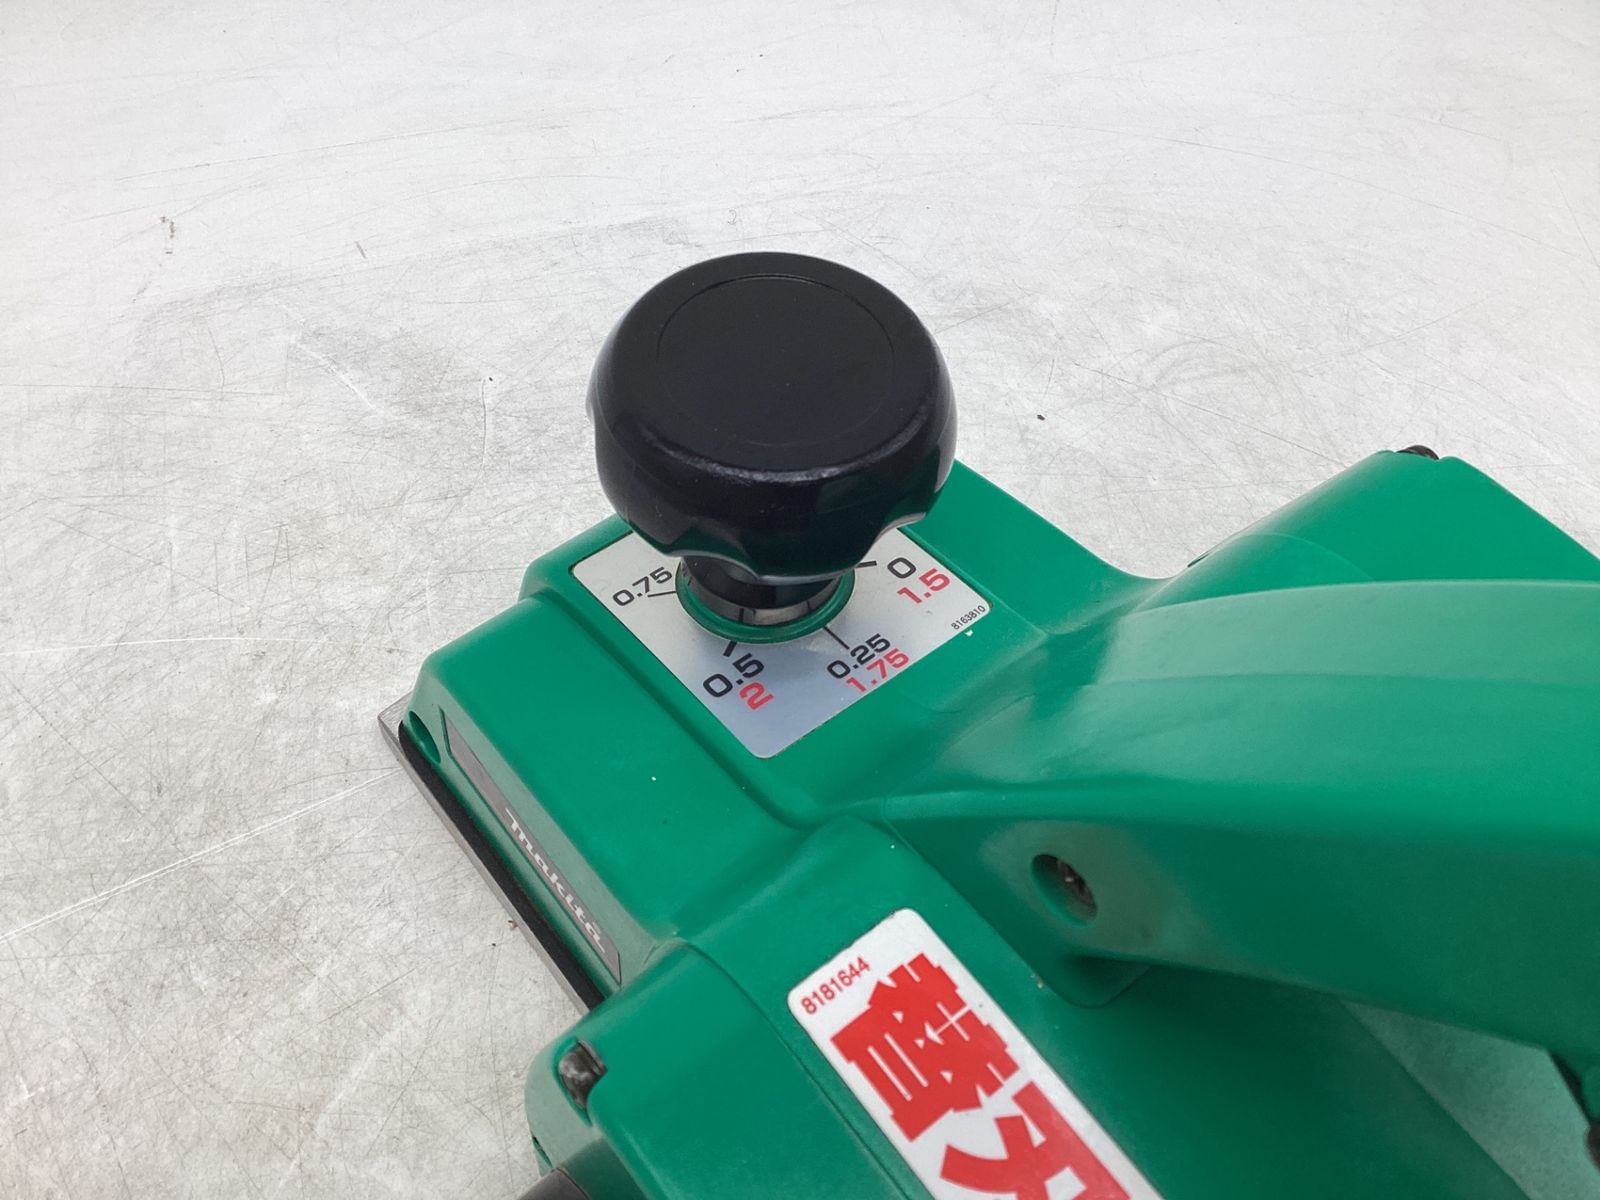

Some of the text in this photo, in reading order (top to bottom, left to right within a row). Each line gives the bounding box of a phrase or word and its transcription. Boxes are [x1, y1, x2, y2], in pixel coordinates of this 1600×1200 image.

[612, 566, 673, 606] 0.75
[887, 557, 917, 578] 0
[897, 568, 950, 603] 1.5
[951, 605, 986, 630] 8163810
[703, 653, 765, 697] 0.5
[826, 634, 890, 679] 0.25
[845, 649, 909, 692] 1.75
[739, 681, 774, 710] 2
[803, 957, 871, 1015] 8181644
